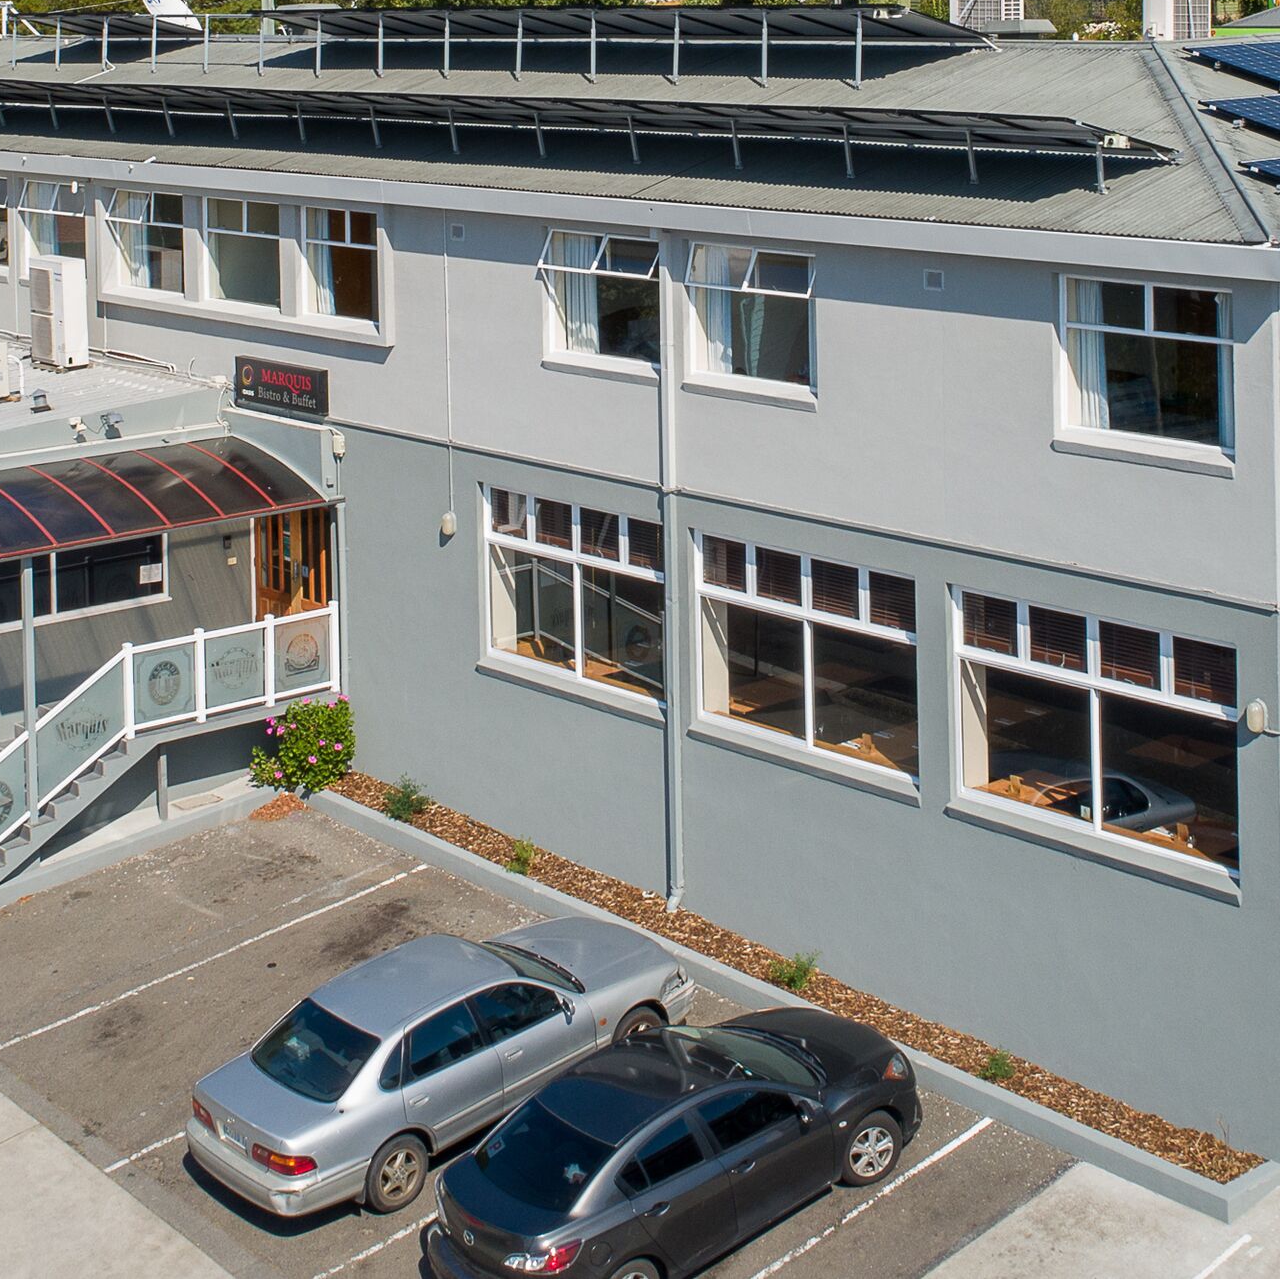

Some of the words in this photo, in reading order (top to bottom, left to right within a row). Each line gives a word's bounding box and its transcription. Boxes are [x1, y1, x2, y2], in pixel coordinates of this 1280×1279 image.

[261, 368, 312, 395] MARQUIS
[258, 386, 281, 401] Bistro
[282, 391, 290, 403] &
[291, 393, 317, 409] Buffet
